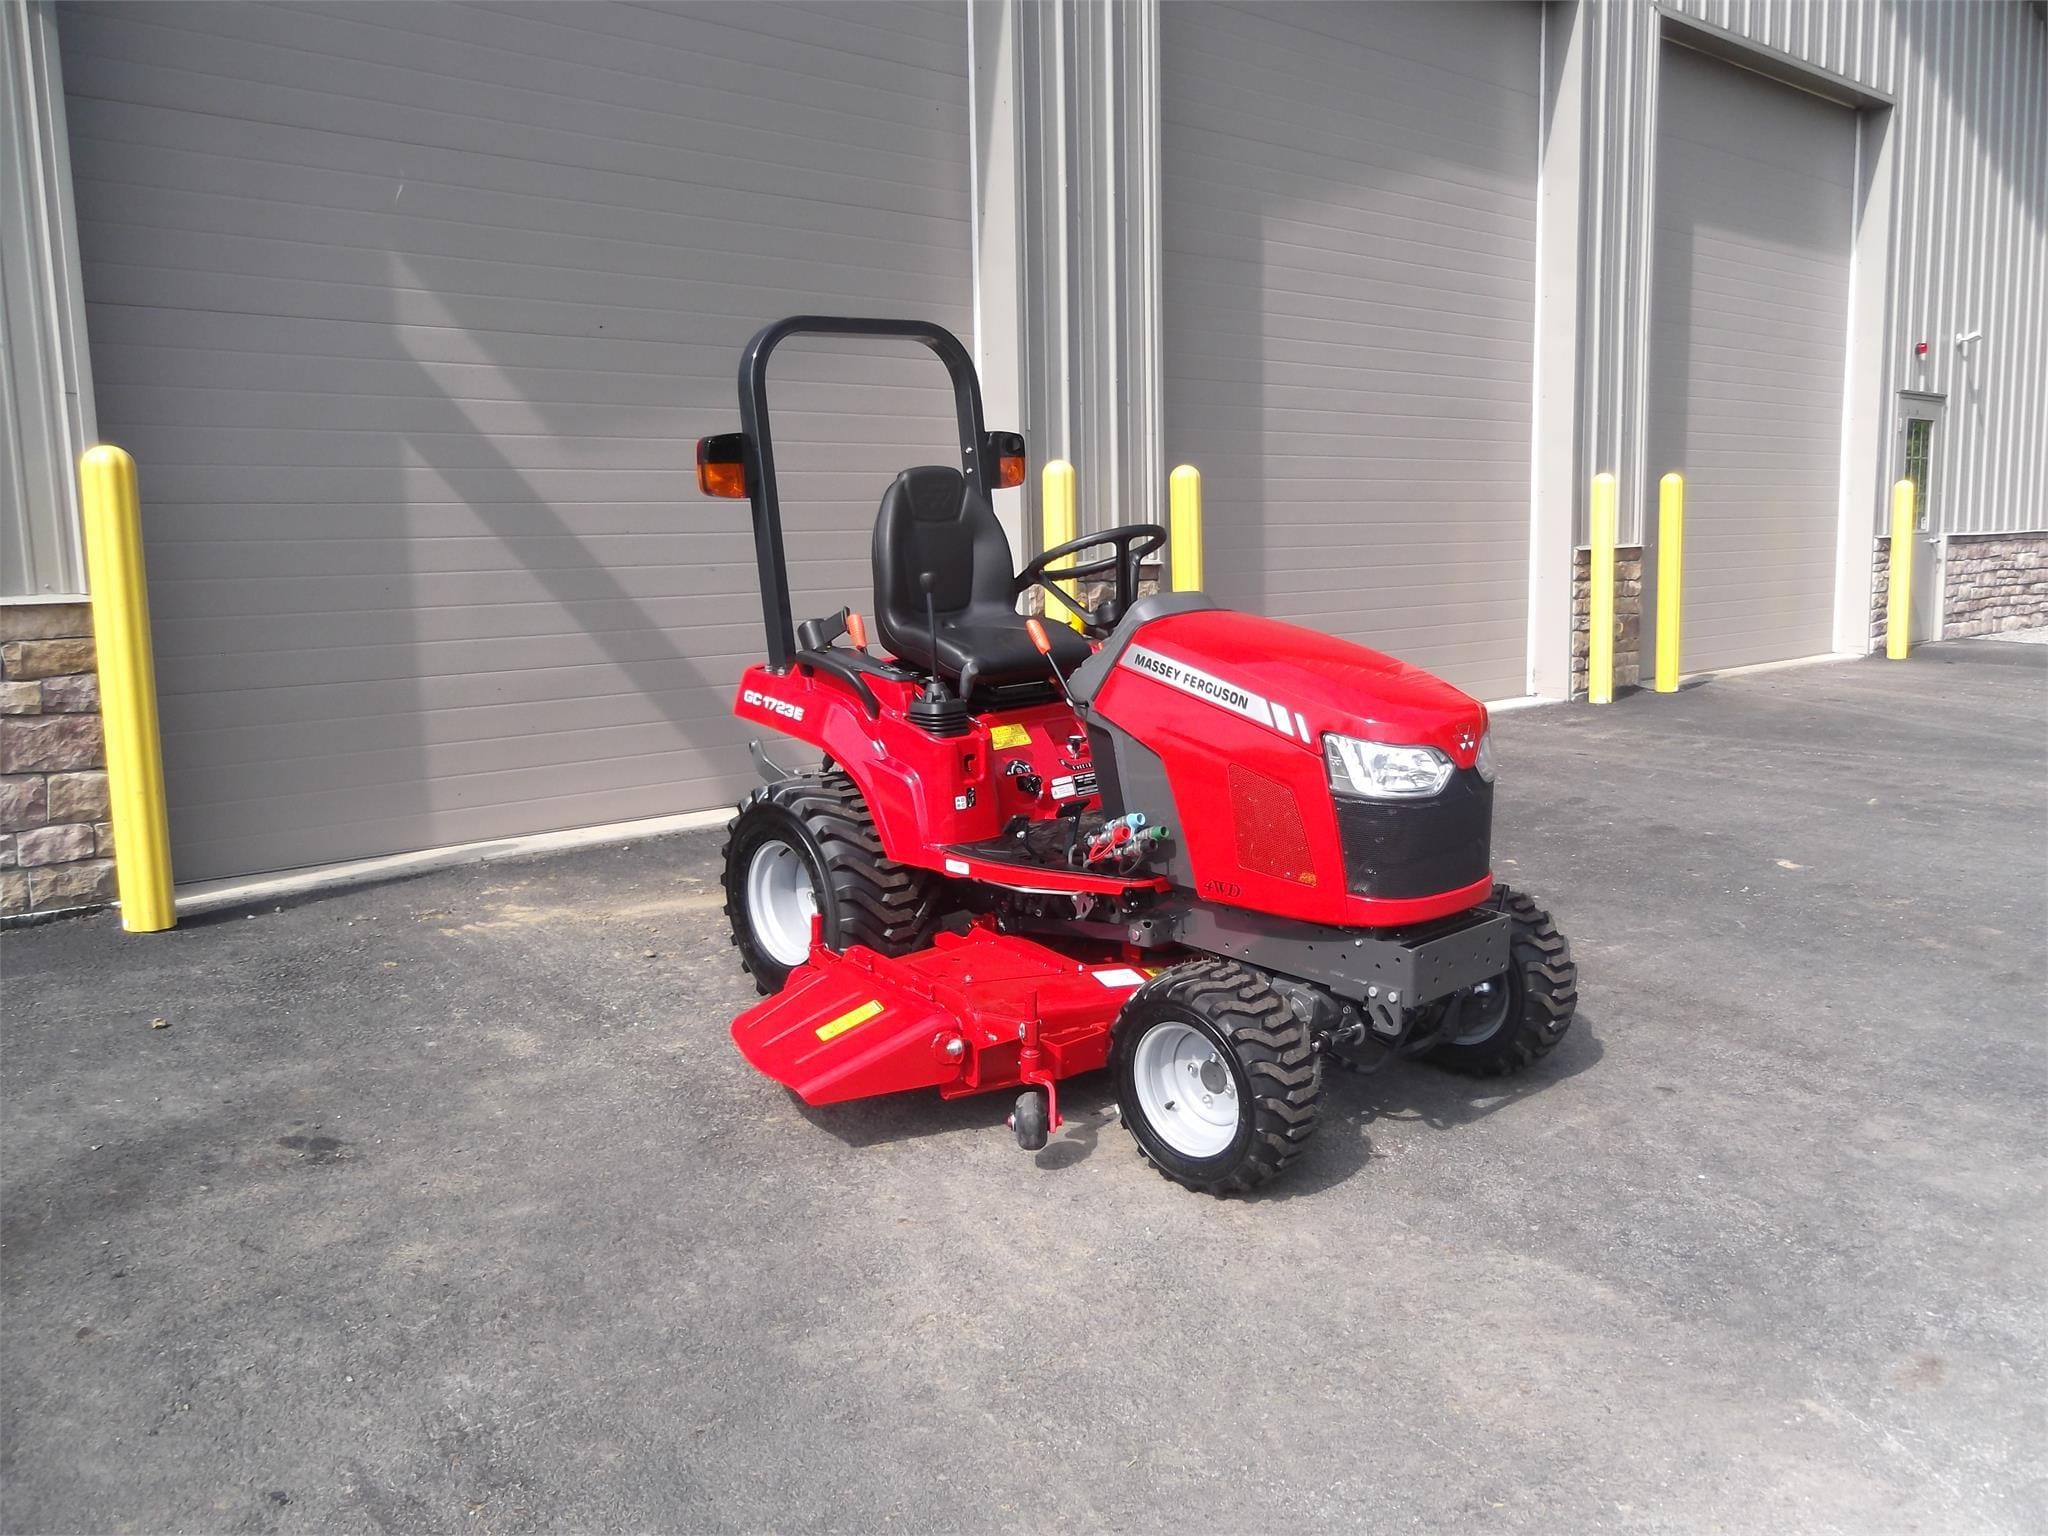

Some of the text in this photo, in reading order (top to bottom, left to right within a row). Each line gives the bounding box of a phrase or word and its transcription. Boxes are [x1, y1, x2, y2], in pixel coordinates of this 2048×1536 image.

[1134, 653, 1249, 710] MASSEY FERGUSON
[1203, 879, 1241, 898] 4WD
